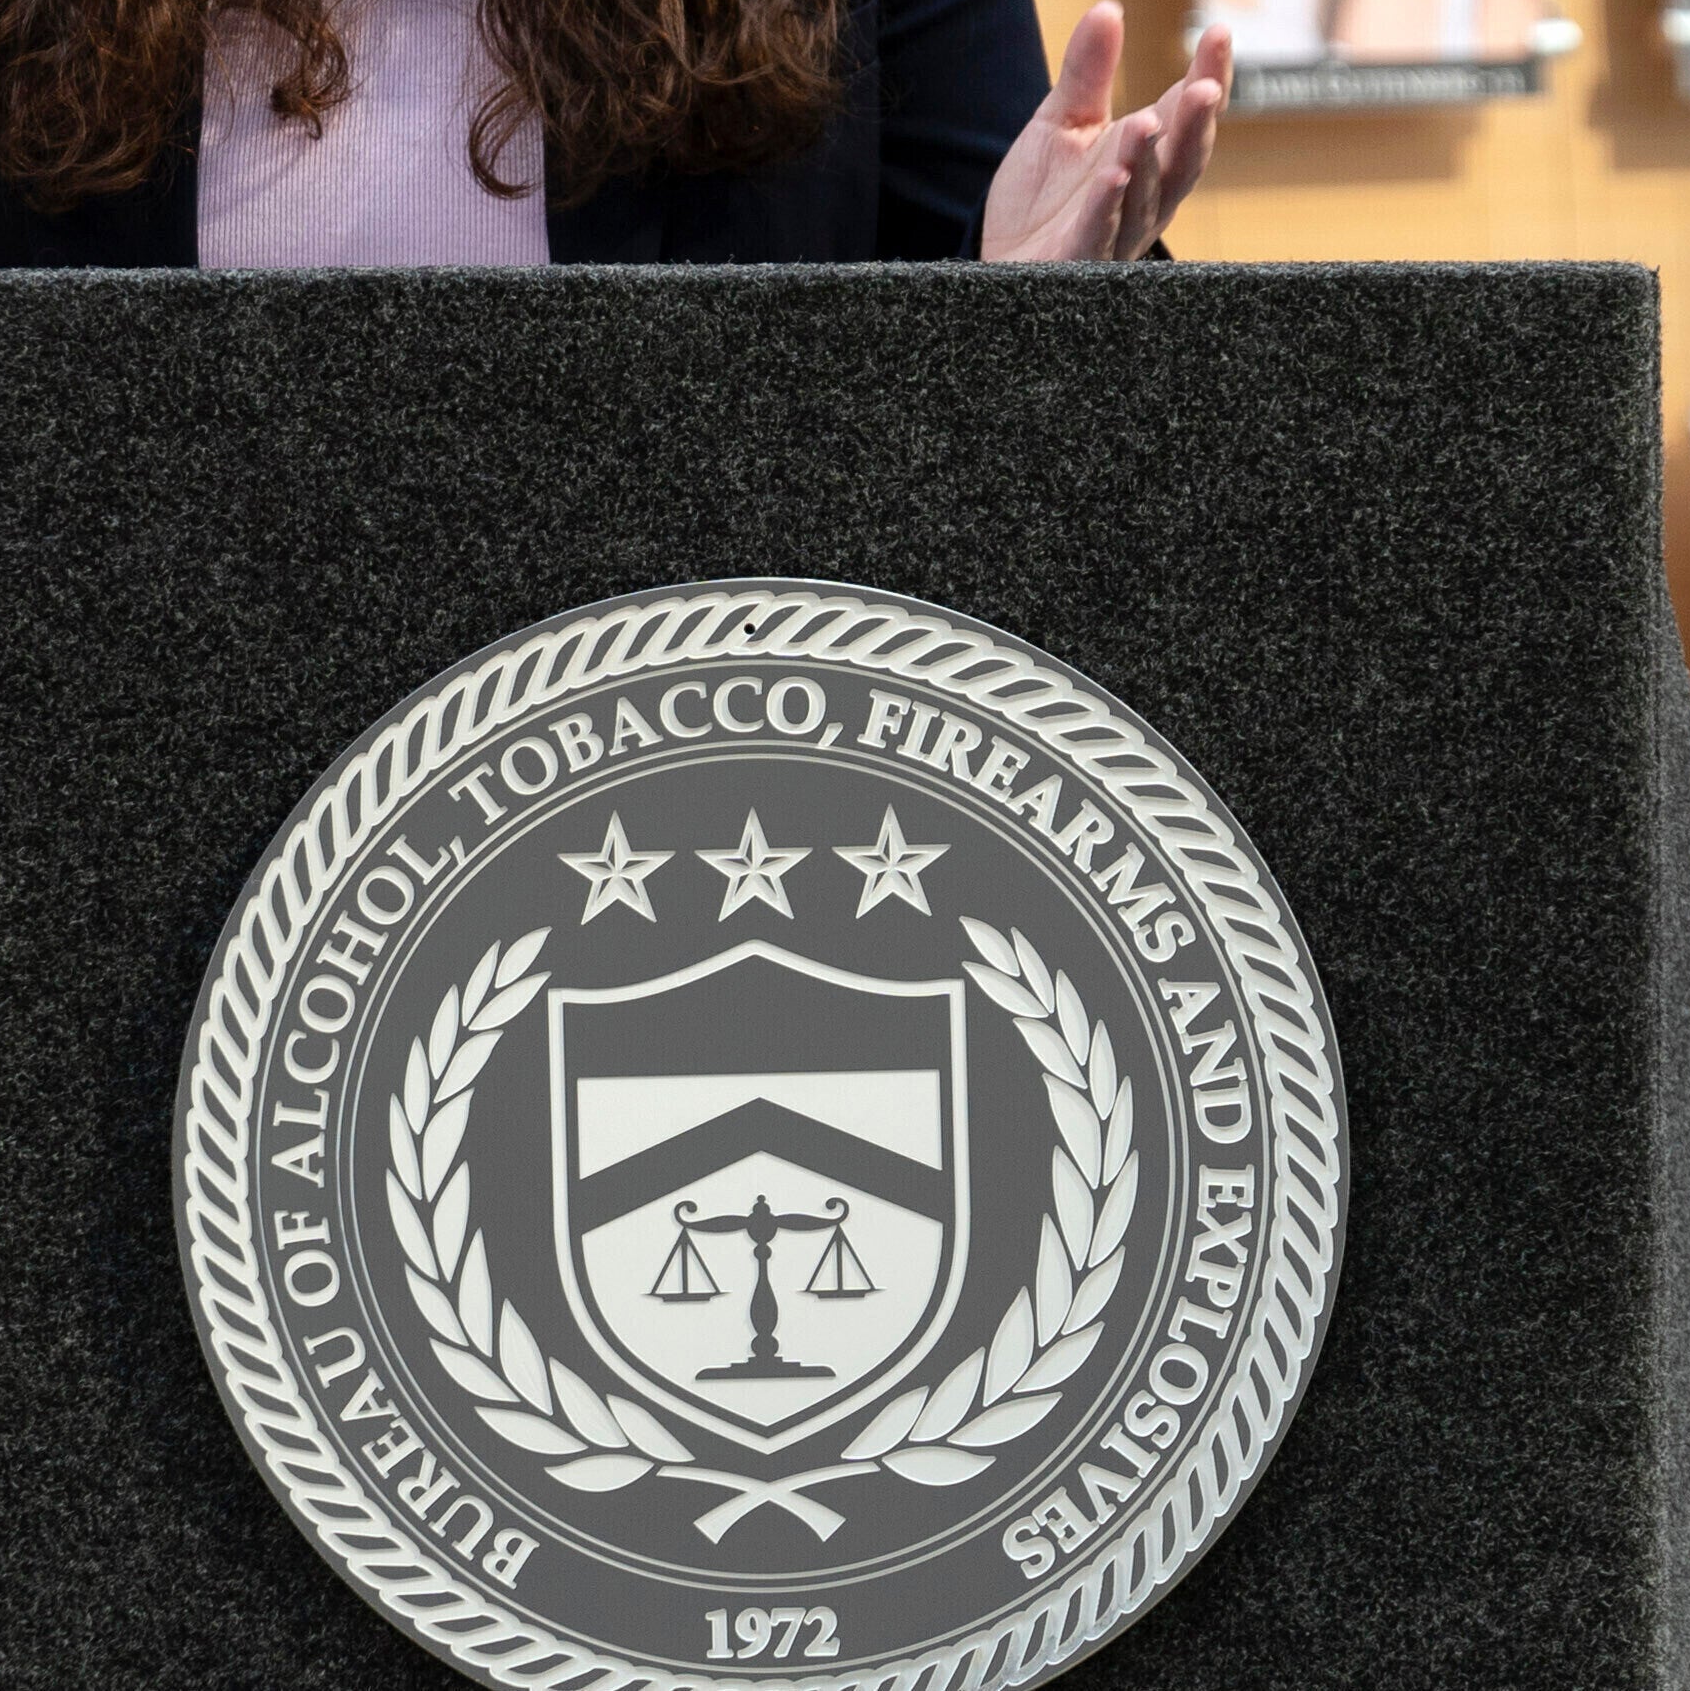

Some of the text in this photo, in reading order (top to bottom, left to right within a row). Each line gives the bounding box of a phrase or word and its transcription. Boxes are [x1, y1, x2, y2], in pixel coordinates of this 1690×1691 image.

[270, 676, 1255, 1590] BUREAU OF ALCOHOL, TOBACCO, FIREARMS AND EXPLOSIVES
[704, 1605, 841, 1660] 1972
